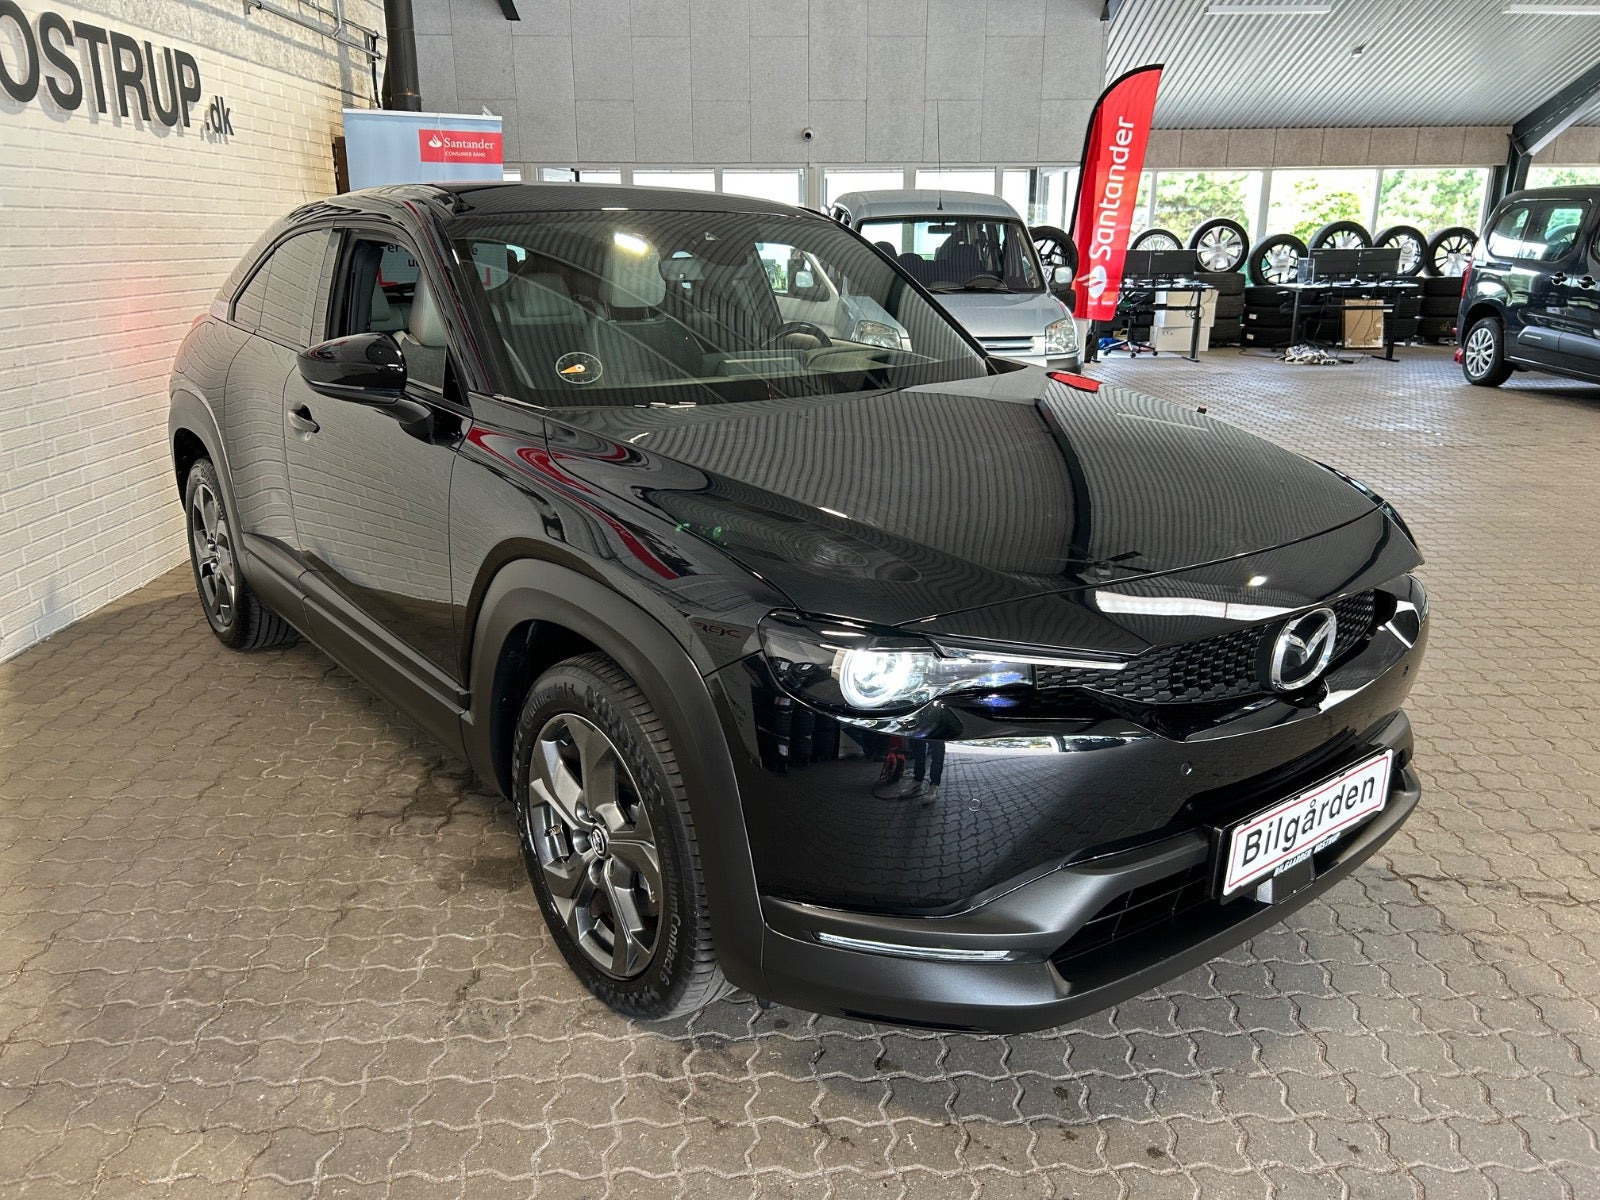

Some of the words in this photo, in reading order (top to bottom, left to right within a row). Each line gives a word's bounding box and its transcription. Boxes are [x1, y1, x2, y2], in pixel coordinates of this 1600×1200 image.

[443, 137, 495, 149] Santander
[1088, 116, 1134, 261] Santander
[1241, 776, 1375, 867] Bilgården
